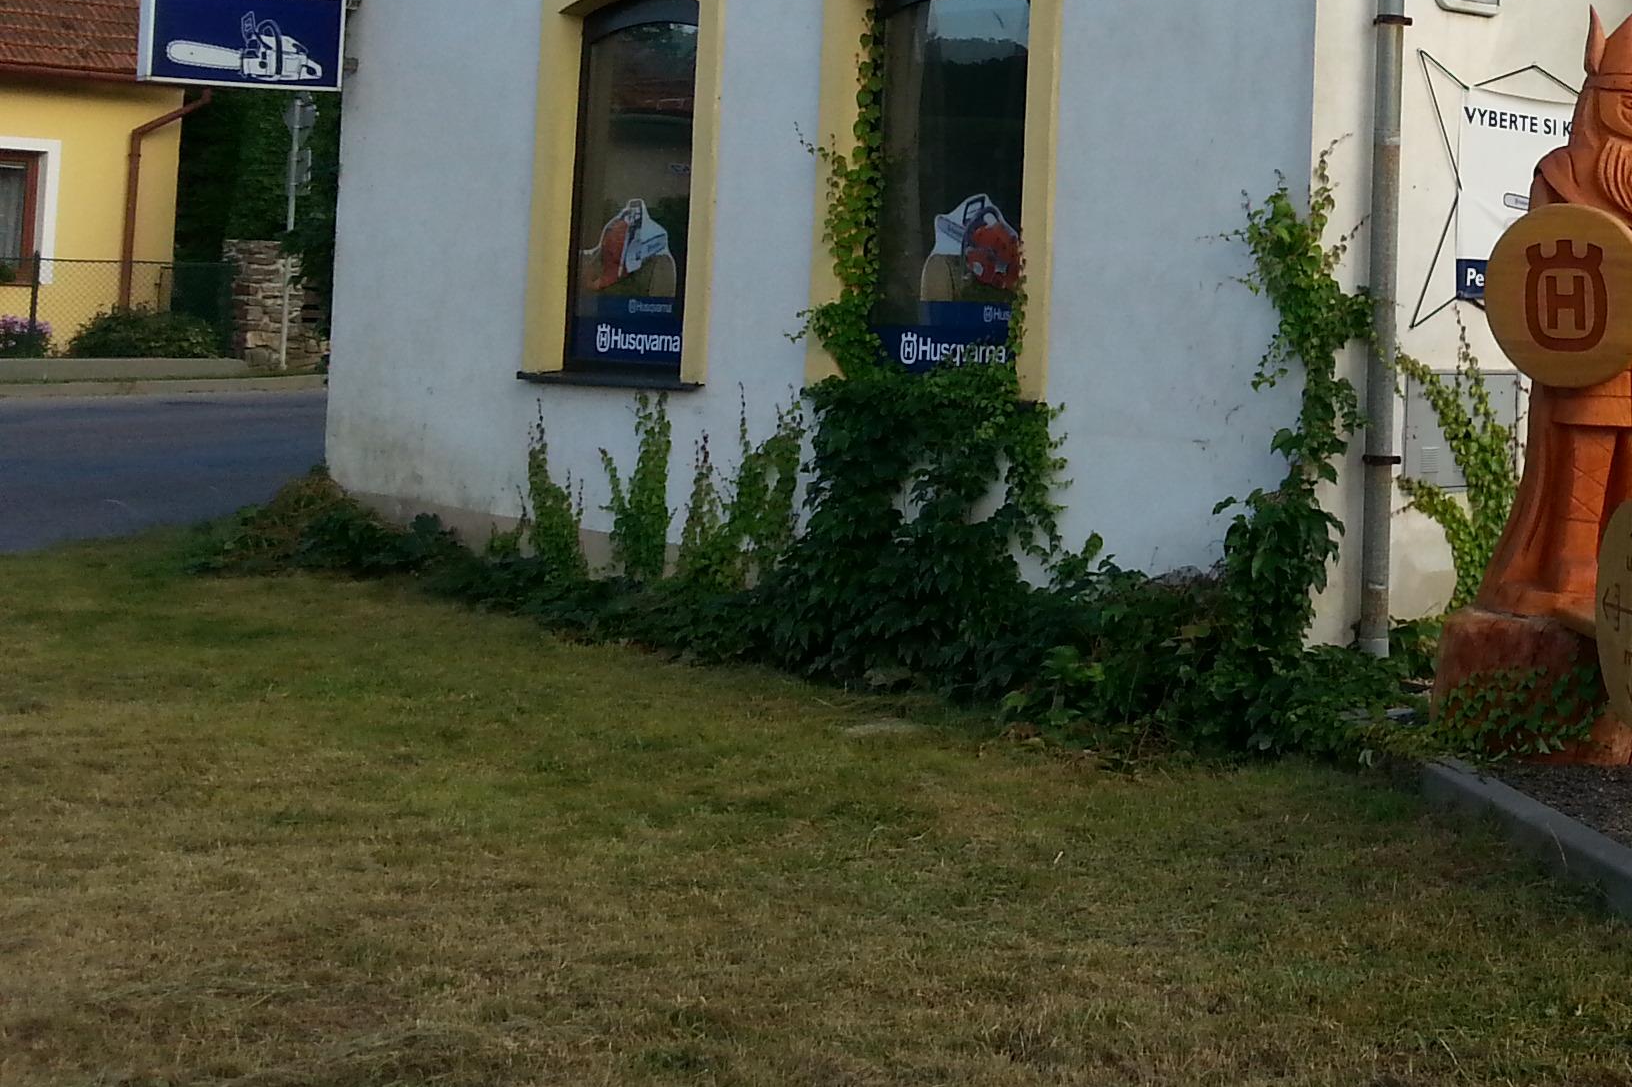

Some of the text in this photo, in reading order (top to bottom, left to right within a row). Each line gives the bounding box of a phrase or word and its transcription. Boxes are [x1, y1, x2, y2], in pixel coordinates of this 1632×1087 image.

[1464, 106, 1573, 137] VYBERTE SI K
[1466, 268, 1485, 287] Pe
[993, 308, 1011, 321] Hus
[611, 328, 681, 354] Husqvarna
